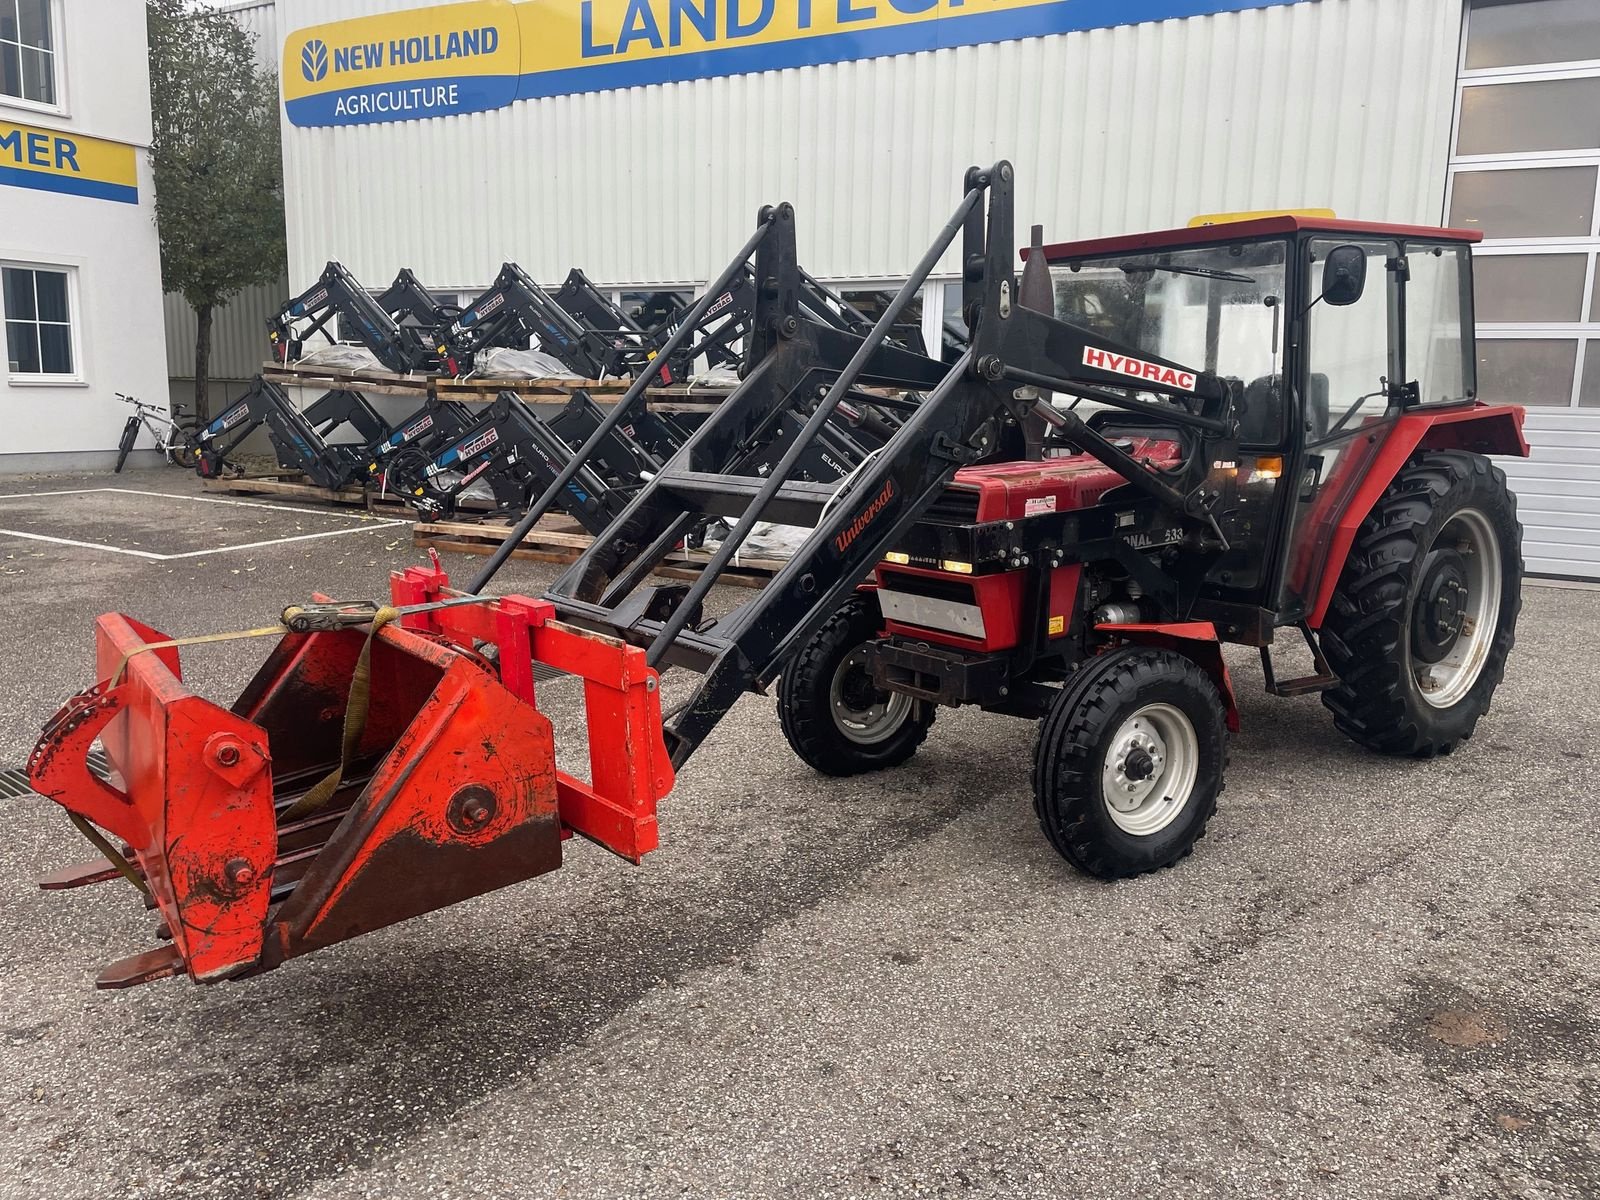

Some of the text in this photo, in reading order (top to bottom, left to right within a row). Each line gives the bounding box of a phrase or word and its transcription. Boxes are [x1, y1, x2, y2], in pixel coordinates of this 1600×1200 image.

[581, 0, 998, 59] LAND
[334, 26, 498, 73] NEW HOLLAND
[334, 84, 459, 117] AGRICULTURE
[0, 130, 80, 172] MER
[480, 297, 503, 316] HYDRAC
[1086, 348, 1193, 389] HYDRAC
[408, 420, 432, 438] HYDRAC
[465, 434, 497, 457] HYDRAC
[531, 443, 549, 462] EURO
[667, 438, 681, 450] EUR
[821, 453, 849, 477] EURO
[834, 479, 894, 552] Universal
